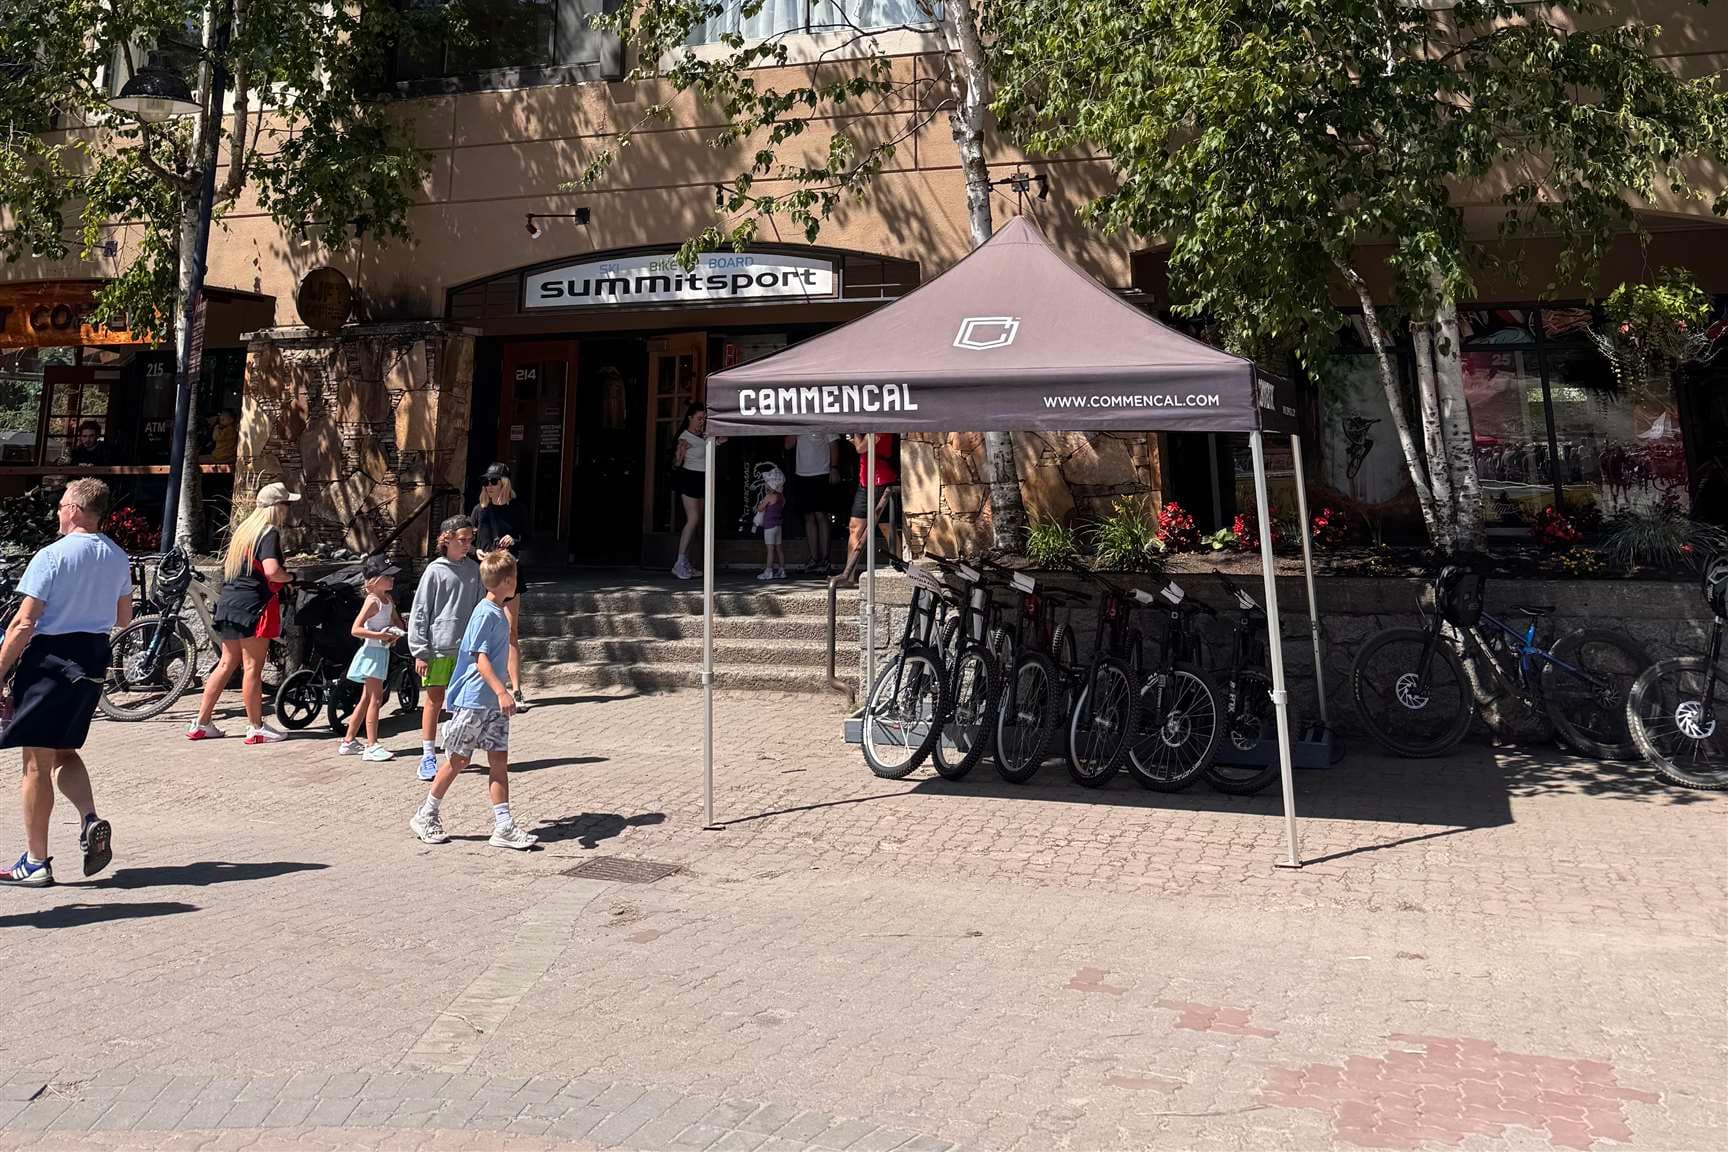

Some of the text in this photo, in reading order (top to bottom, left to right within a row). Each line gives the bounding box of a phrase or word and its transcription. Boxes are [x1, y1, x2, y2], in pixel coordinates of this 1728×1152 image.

[708, 256, 754, 270] BOARD
[540, 269, 817, 299] summitsport
[147, 363, 164, 377] 215
[516, 369, 536, 381] 214
[738, 384, 919, 416] COMMENCAL
[1043, 394, 1220, 408] WWW.COMMENCAL.COM
[145, 422, 166, 433] ATM
